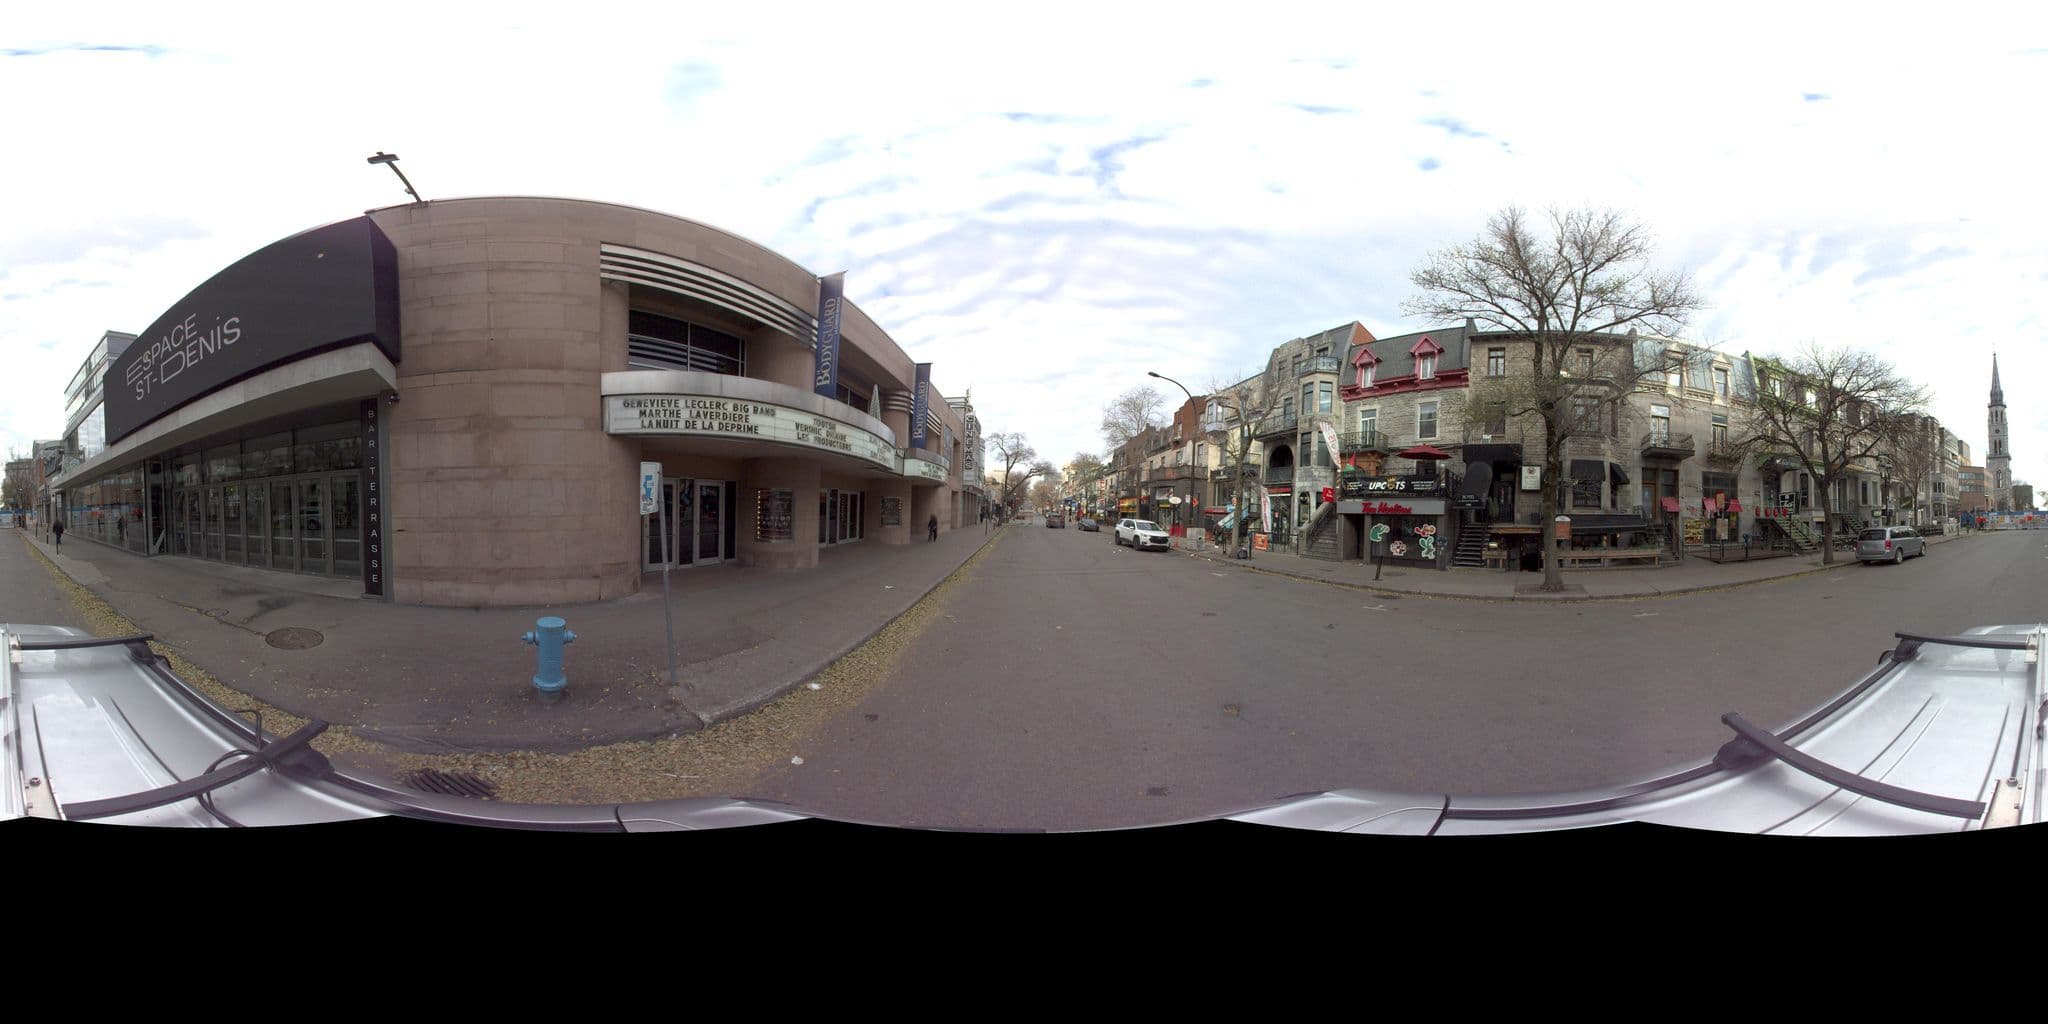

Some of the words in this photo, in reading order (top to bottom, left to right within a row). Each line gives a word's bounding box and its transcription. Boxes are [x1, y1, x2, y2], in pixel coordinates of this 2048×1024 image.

[126, 313, 197, 385] ESPACE
[816, 298, 836, 386] BODYGUARD
[623, 399, 680, 408] GENEVIEVE
[685, 400, 728, 411] LECLERC
[733, 403, 749, 413] BIG
[640, 409, 681, 419] MARTHE
[690, 410, 750, 423] LAVERDIERE
[913, 382, 927, 439] BODYGUARD
[685, 420, 697, 430] DE
[702, 421, 714, 430] LA
[718, 422, 759, 434] DEPRIME
